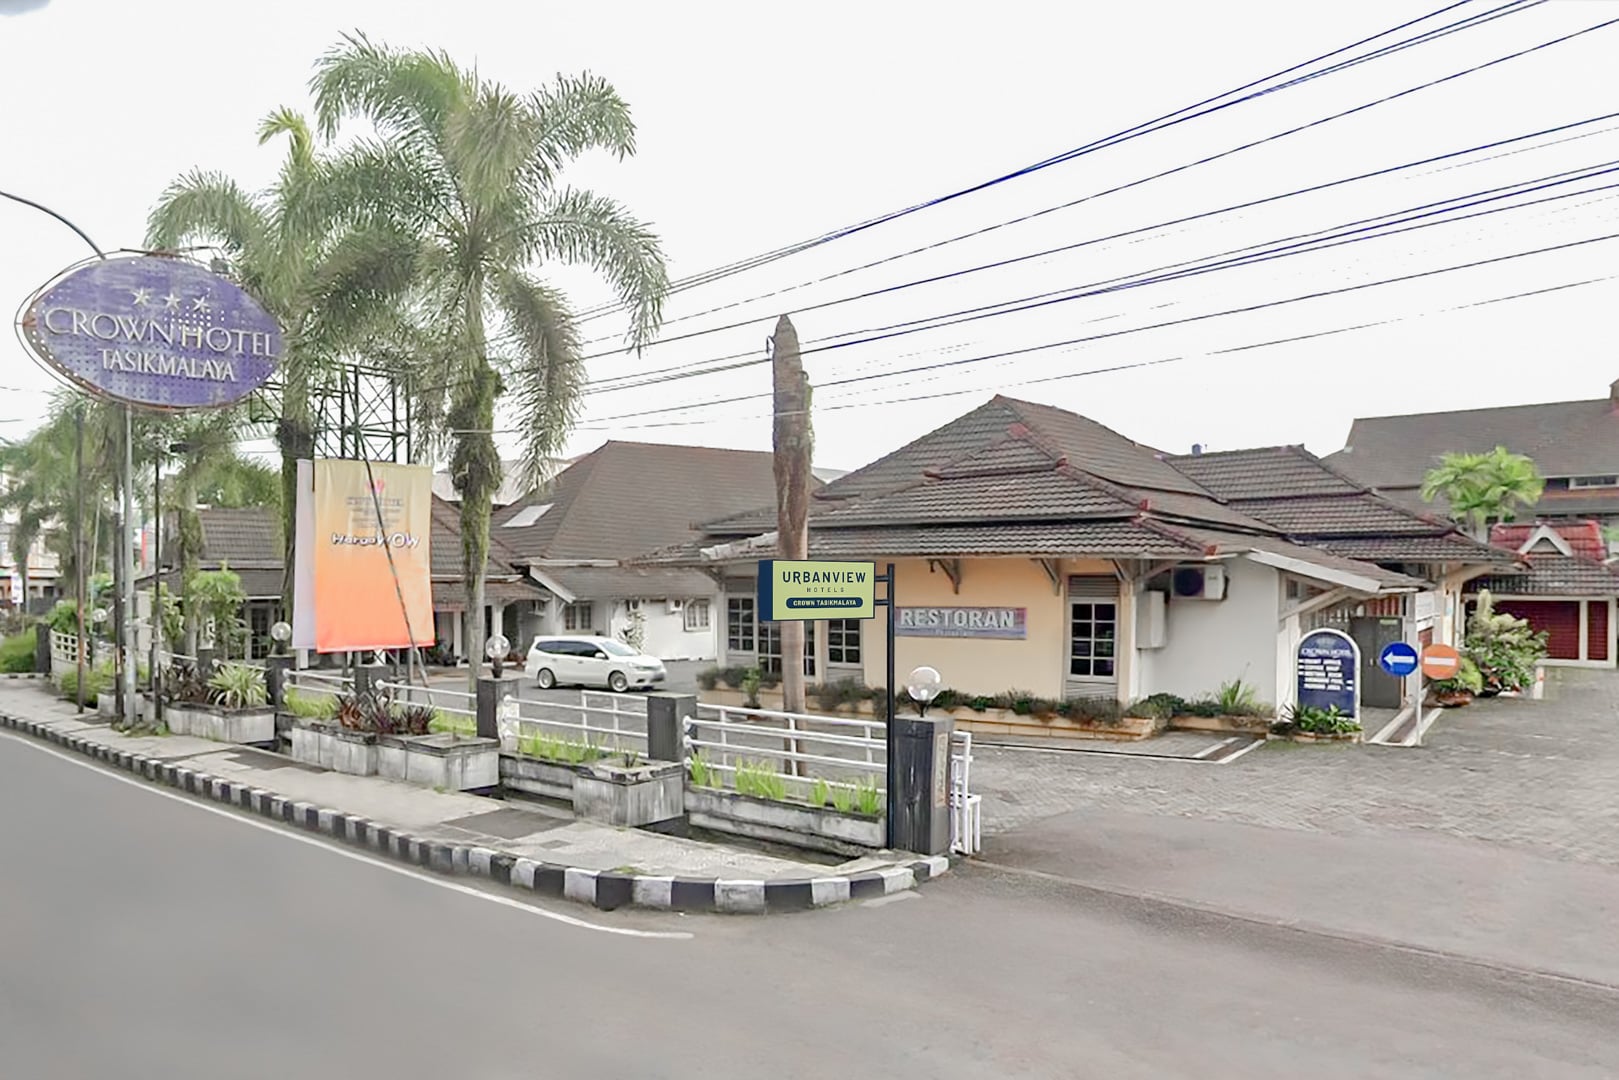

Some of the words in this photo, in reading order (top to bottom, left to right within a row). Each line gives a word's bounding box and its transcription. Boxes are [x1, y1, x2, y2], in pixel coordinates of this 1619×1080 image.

[44, 306, 174, 347] CROWN
[181, 326, 276, 358] HOTEL
[98, 348, 237, 382] TASIKMALAYA
[782, 571, 866, 584] URBANVIEW
[900, 609, 1014, 629] RESTORAN
